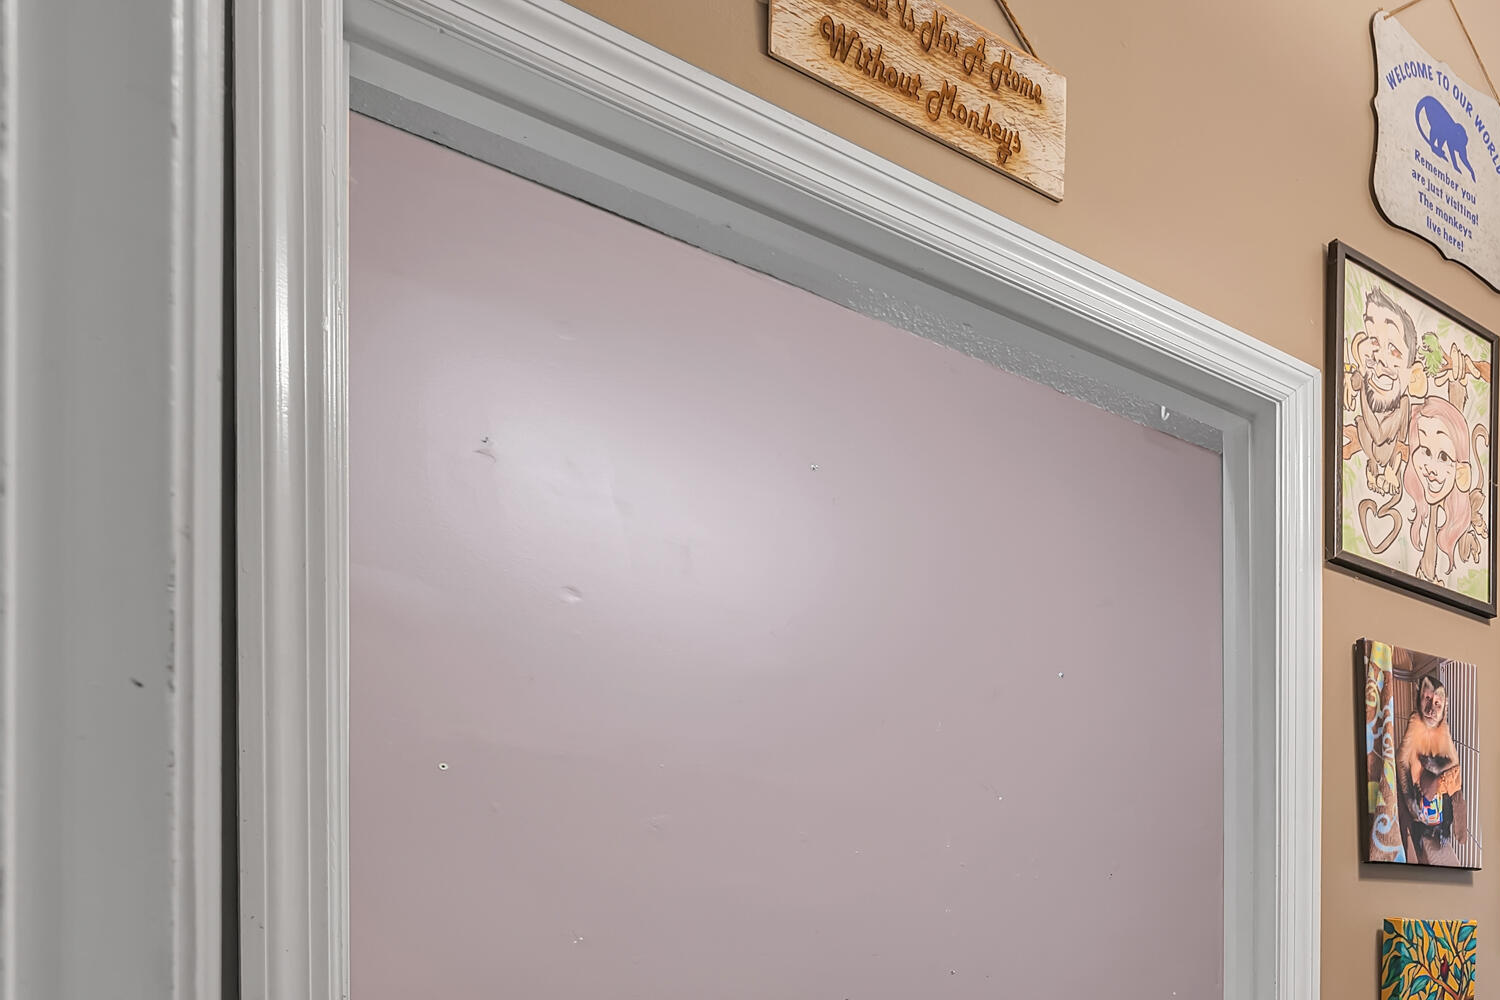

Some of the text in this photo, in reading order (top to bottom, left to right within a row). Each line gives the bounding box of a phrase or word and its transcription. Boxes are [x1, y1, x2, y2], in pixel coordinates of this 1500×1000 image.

[919, 10, 960, 58] Not
[962, 37, 986, 76] A
[990, 50, 1043, 104] Home
[819, 15, 1022, 164] Without Monkeys
[1385, 60, 1434, 90] WELCOME
[1436, 71, 1450, 91] TO
[1452, 84, 1473, 118] OUR
[1411, 169, 1479, 226] are just visiting!
[1414, 149, 1476, 205] Remember you
[1418, 191, 1473, 240] The monkeys
[1426, 215, 1464, 252] live here!
